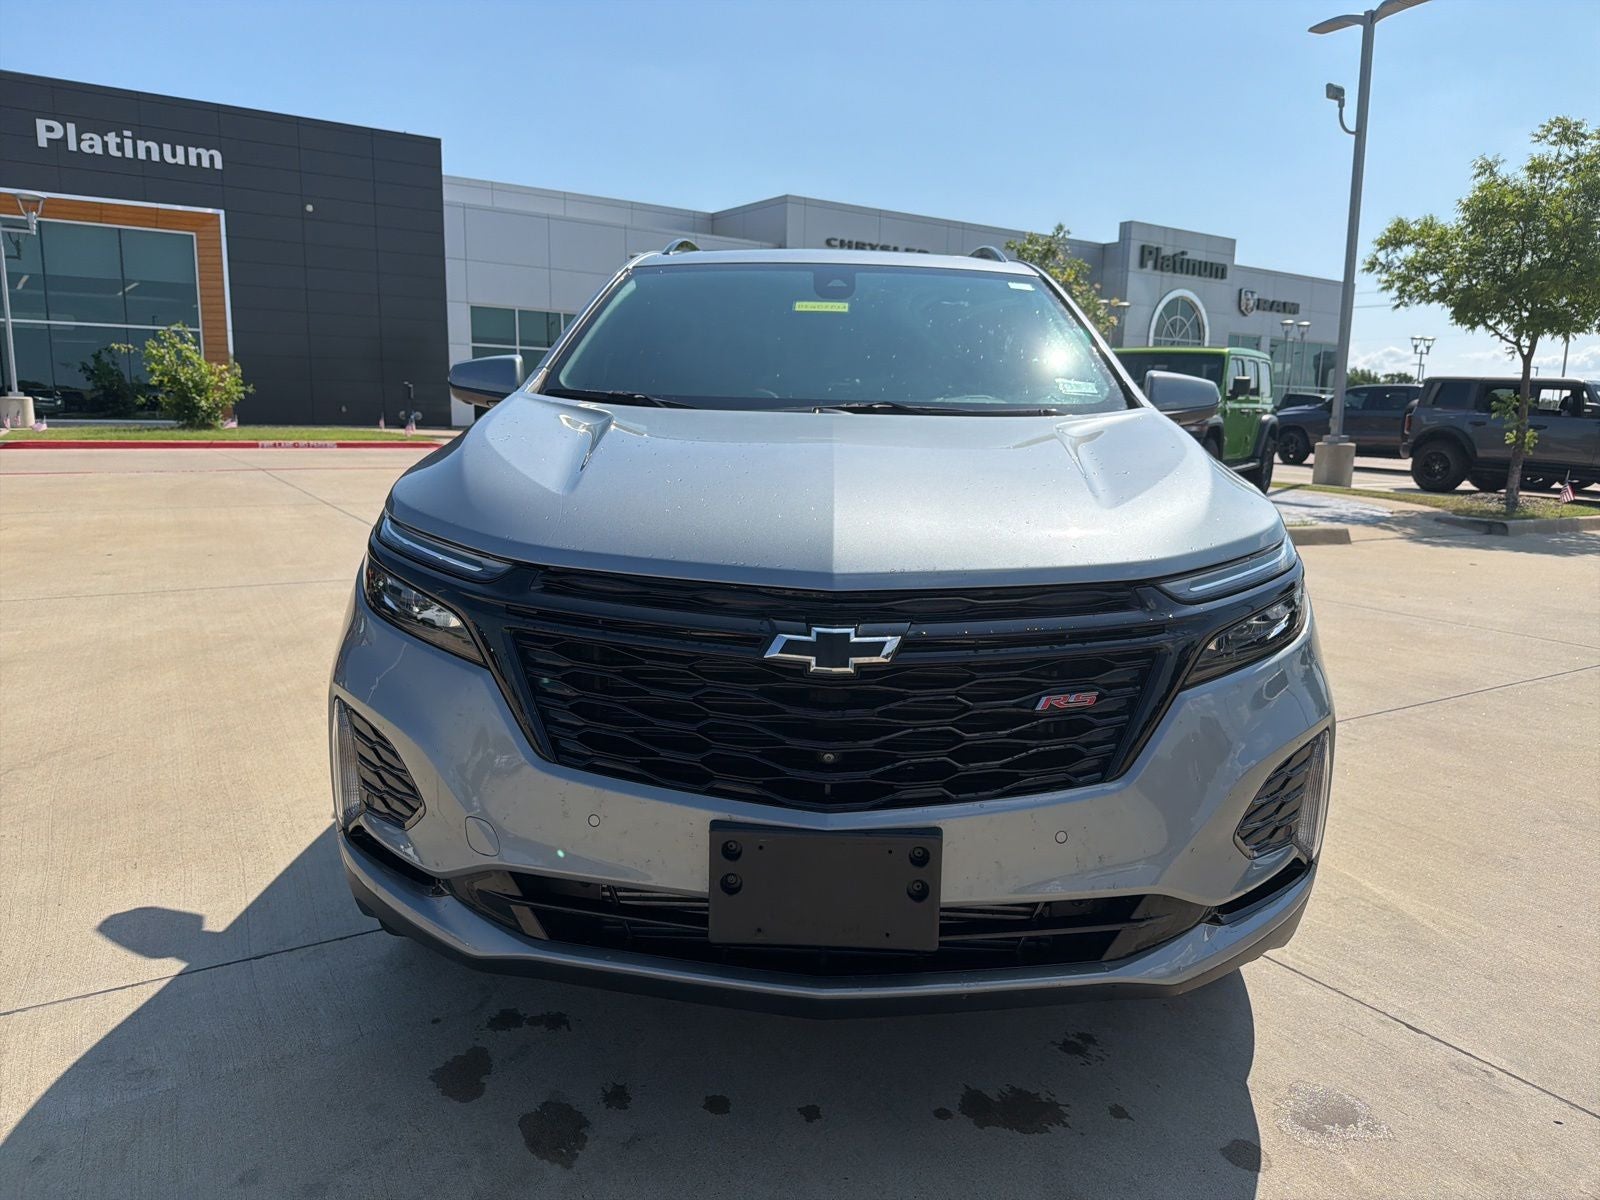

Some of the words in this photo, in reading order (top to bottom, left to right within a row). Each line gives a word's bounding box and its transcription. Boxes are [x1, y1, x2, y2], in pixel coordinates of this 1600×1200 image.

[35, 118, 223, 170] Platinum
[1138, 244, 1228, 280] Platinum
[1034, 691, 1099, 711] RS
